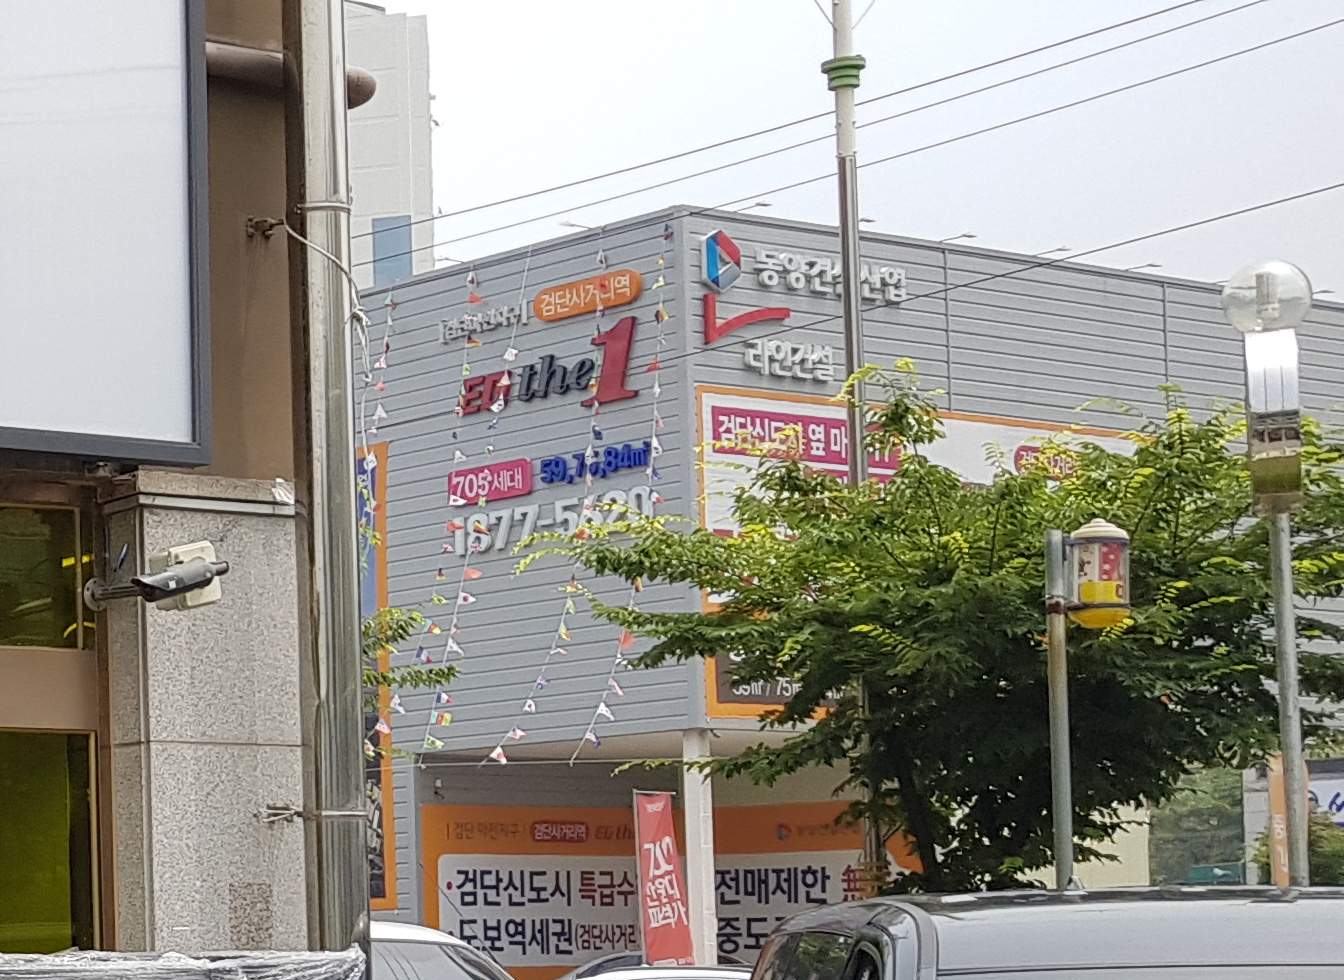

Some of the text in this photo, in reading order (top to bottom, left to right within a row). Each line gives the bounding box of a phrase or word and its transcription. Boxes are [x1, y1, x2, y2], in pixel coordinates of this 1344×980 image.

[754, 249, 907, 303] 동양건산업
[744, 339, 835, 381] 라인건설
[808, 424, 826, 456] 옆
[452, 467, 524, 498] 705세대
[456, 868, 572, 907] 검단신도시
[715, 865, 831, 906] 전매제한
